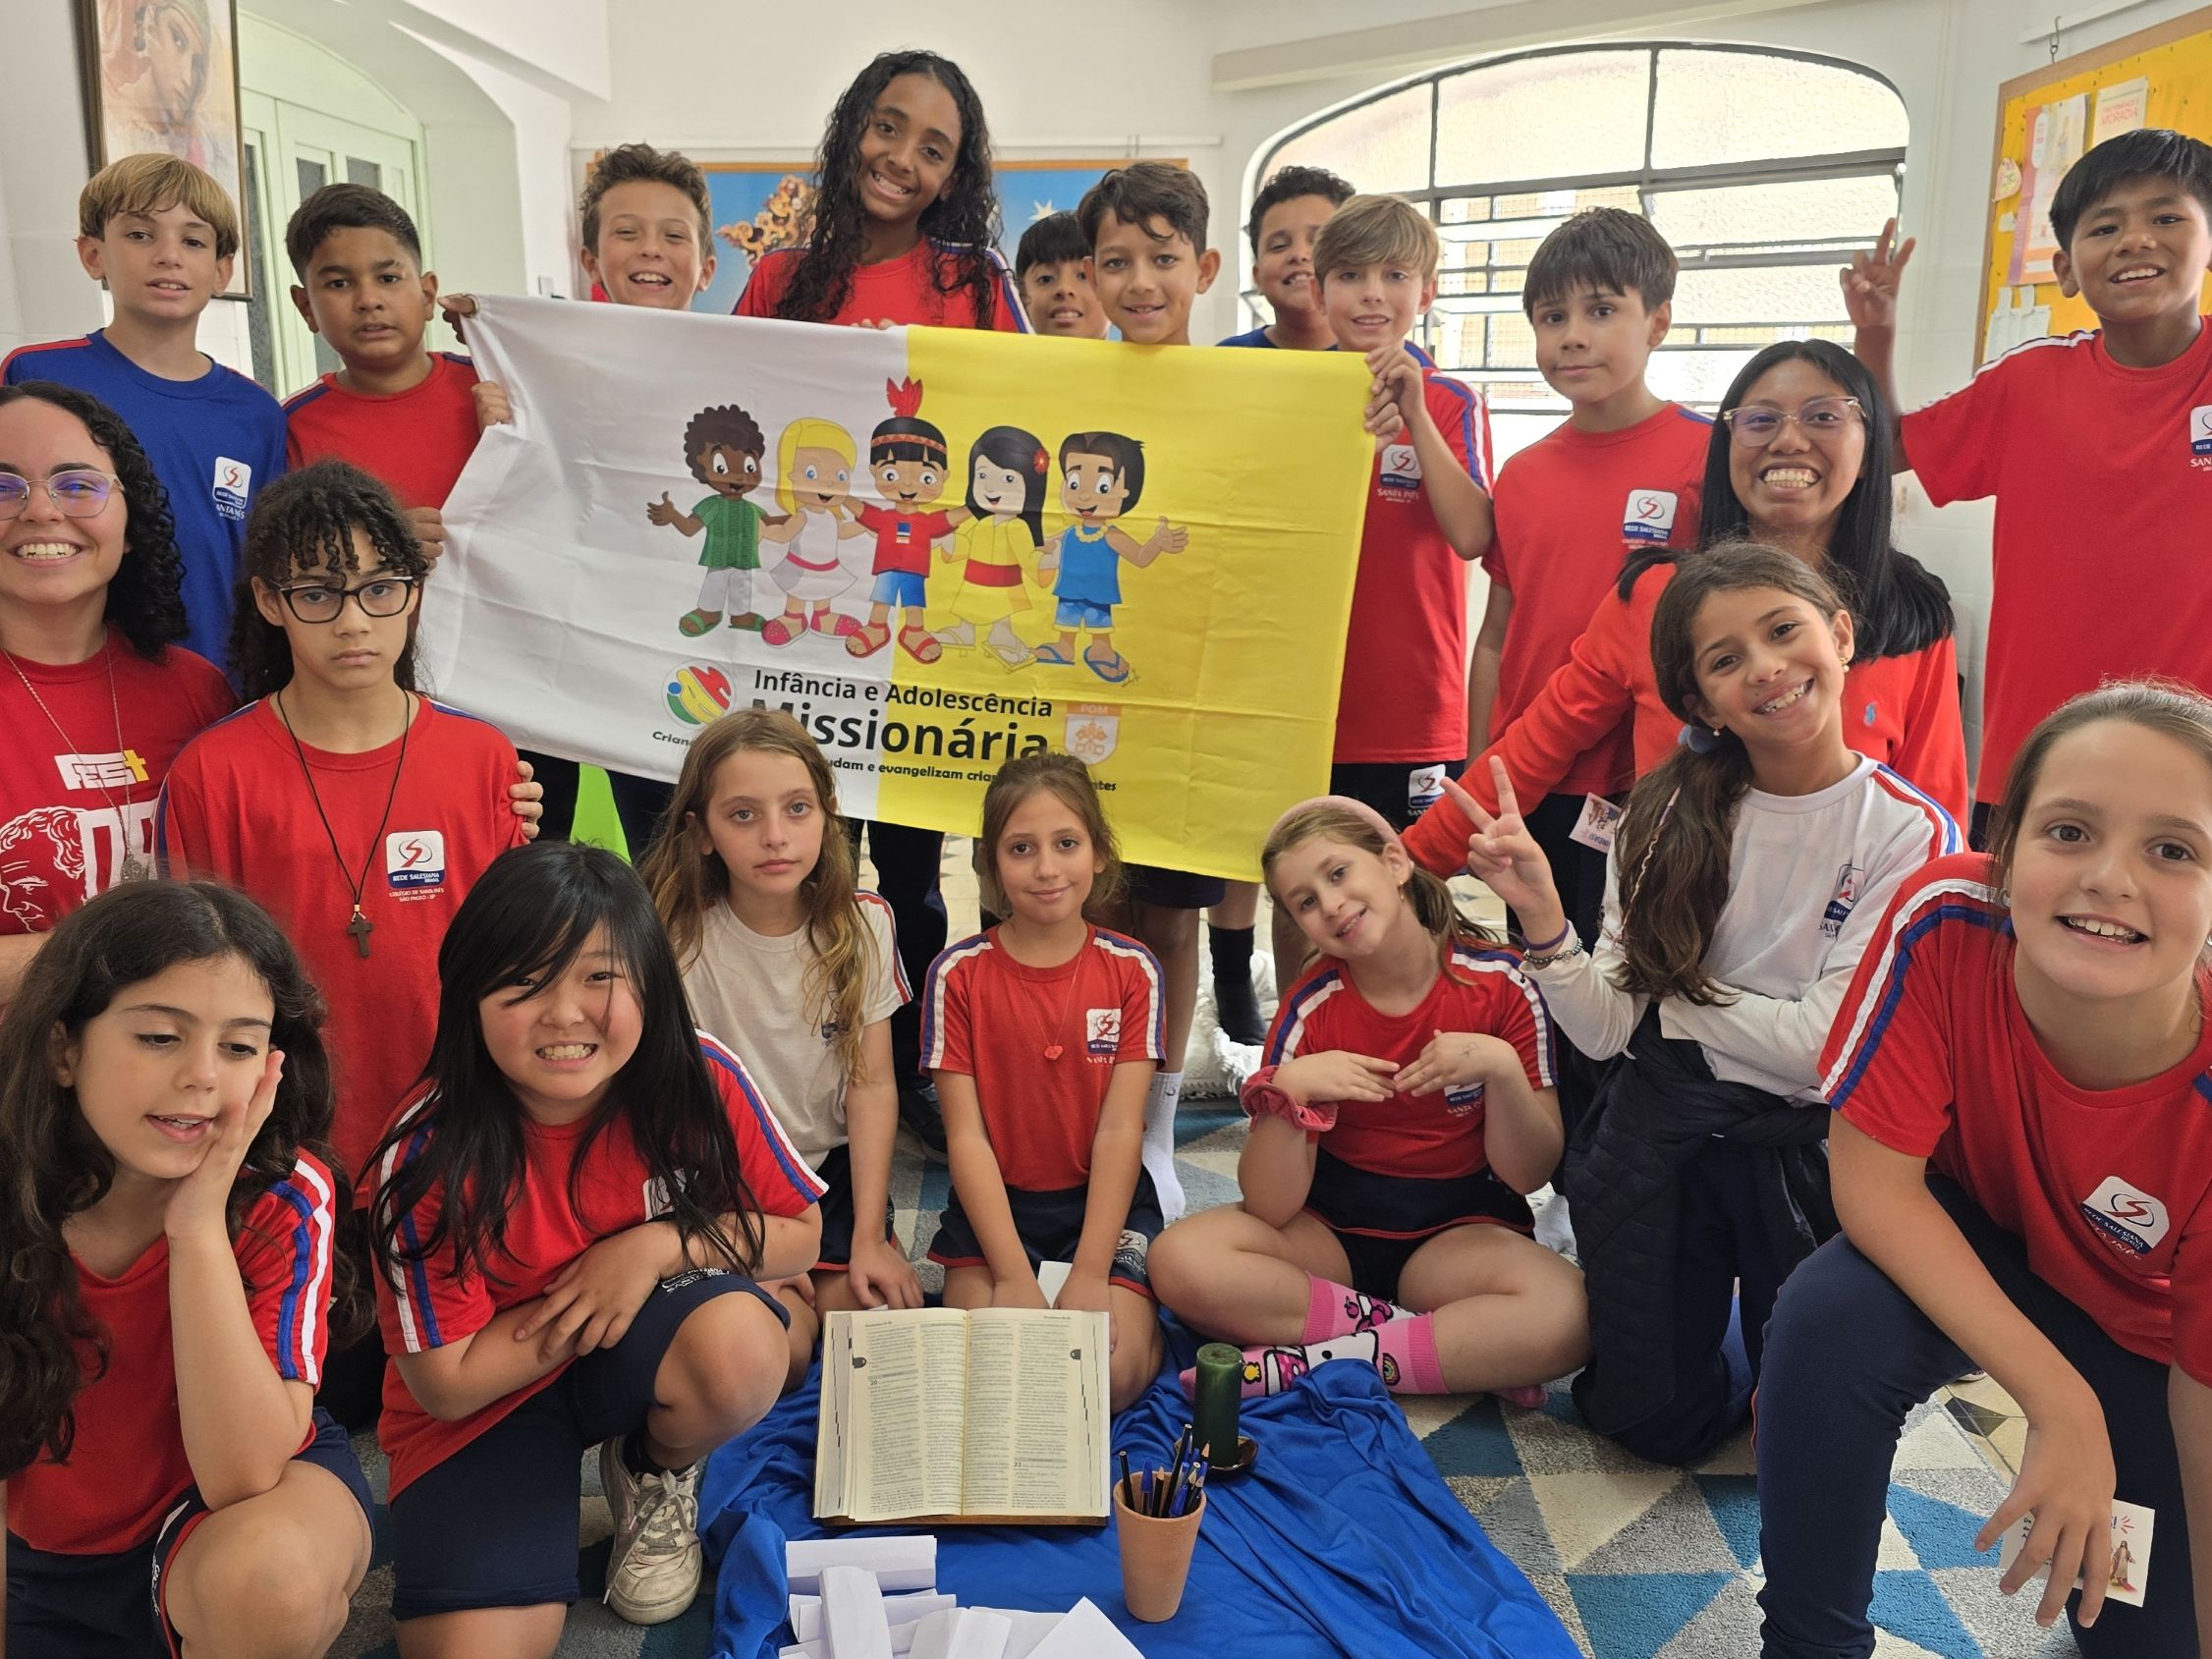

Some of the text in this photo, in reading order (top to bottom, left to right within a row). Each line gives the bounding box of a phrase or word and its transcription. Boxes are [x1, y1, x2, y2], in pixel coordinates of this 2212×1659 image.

[754, 669, 1053, 717] Infância e Adolescência
[867, 763, 875, 772] e
[878, 764, 963, 780] evangelizam
